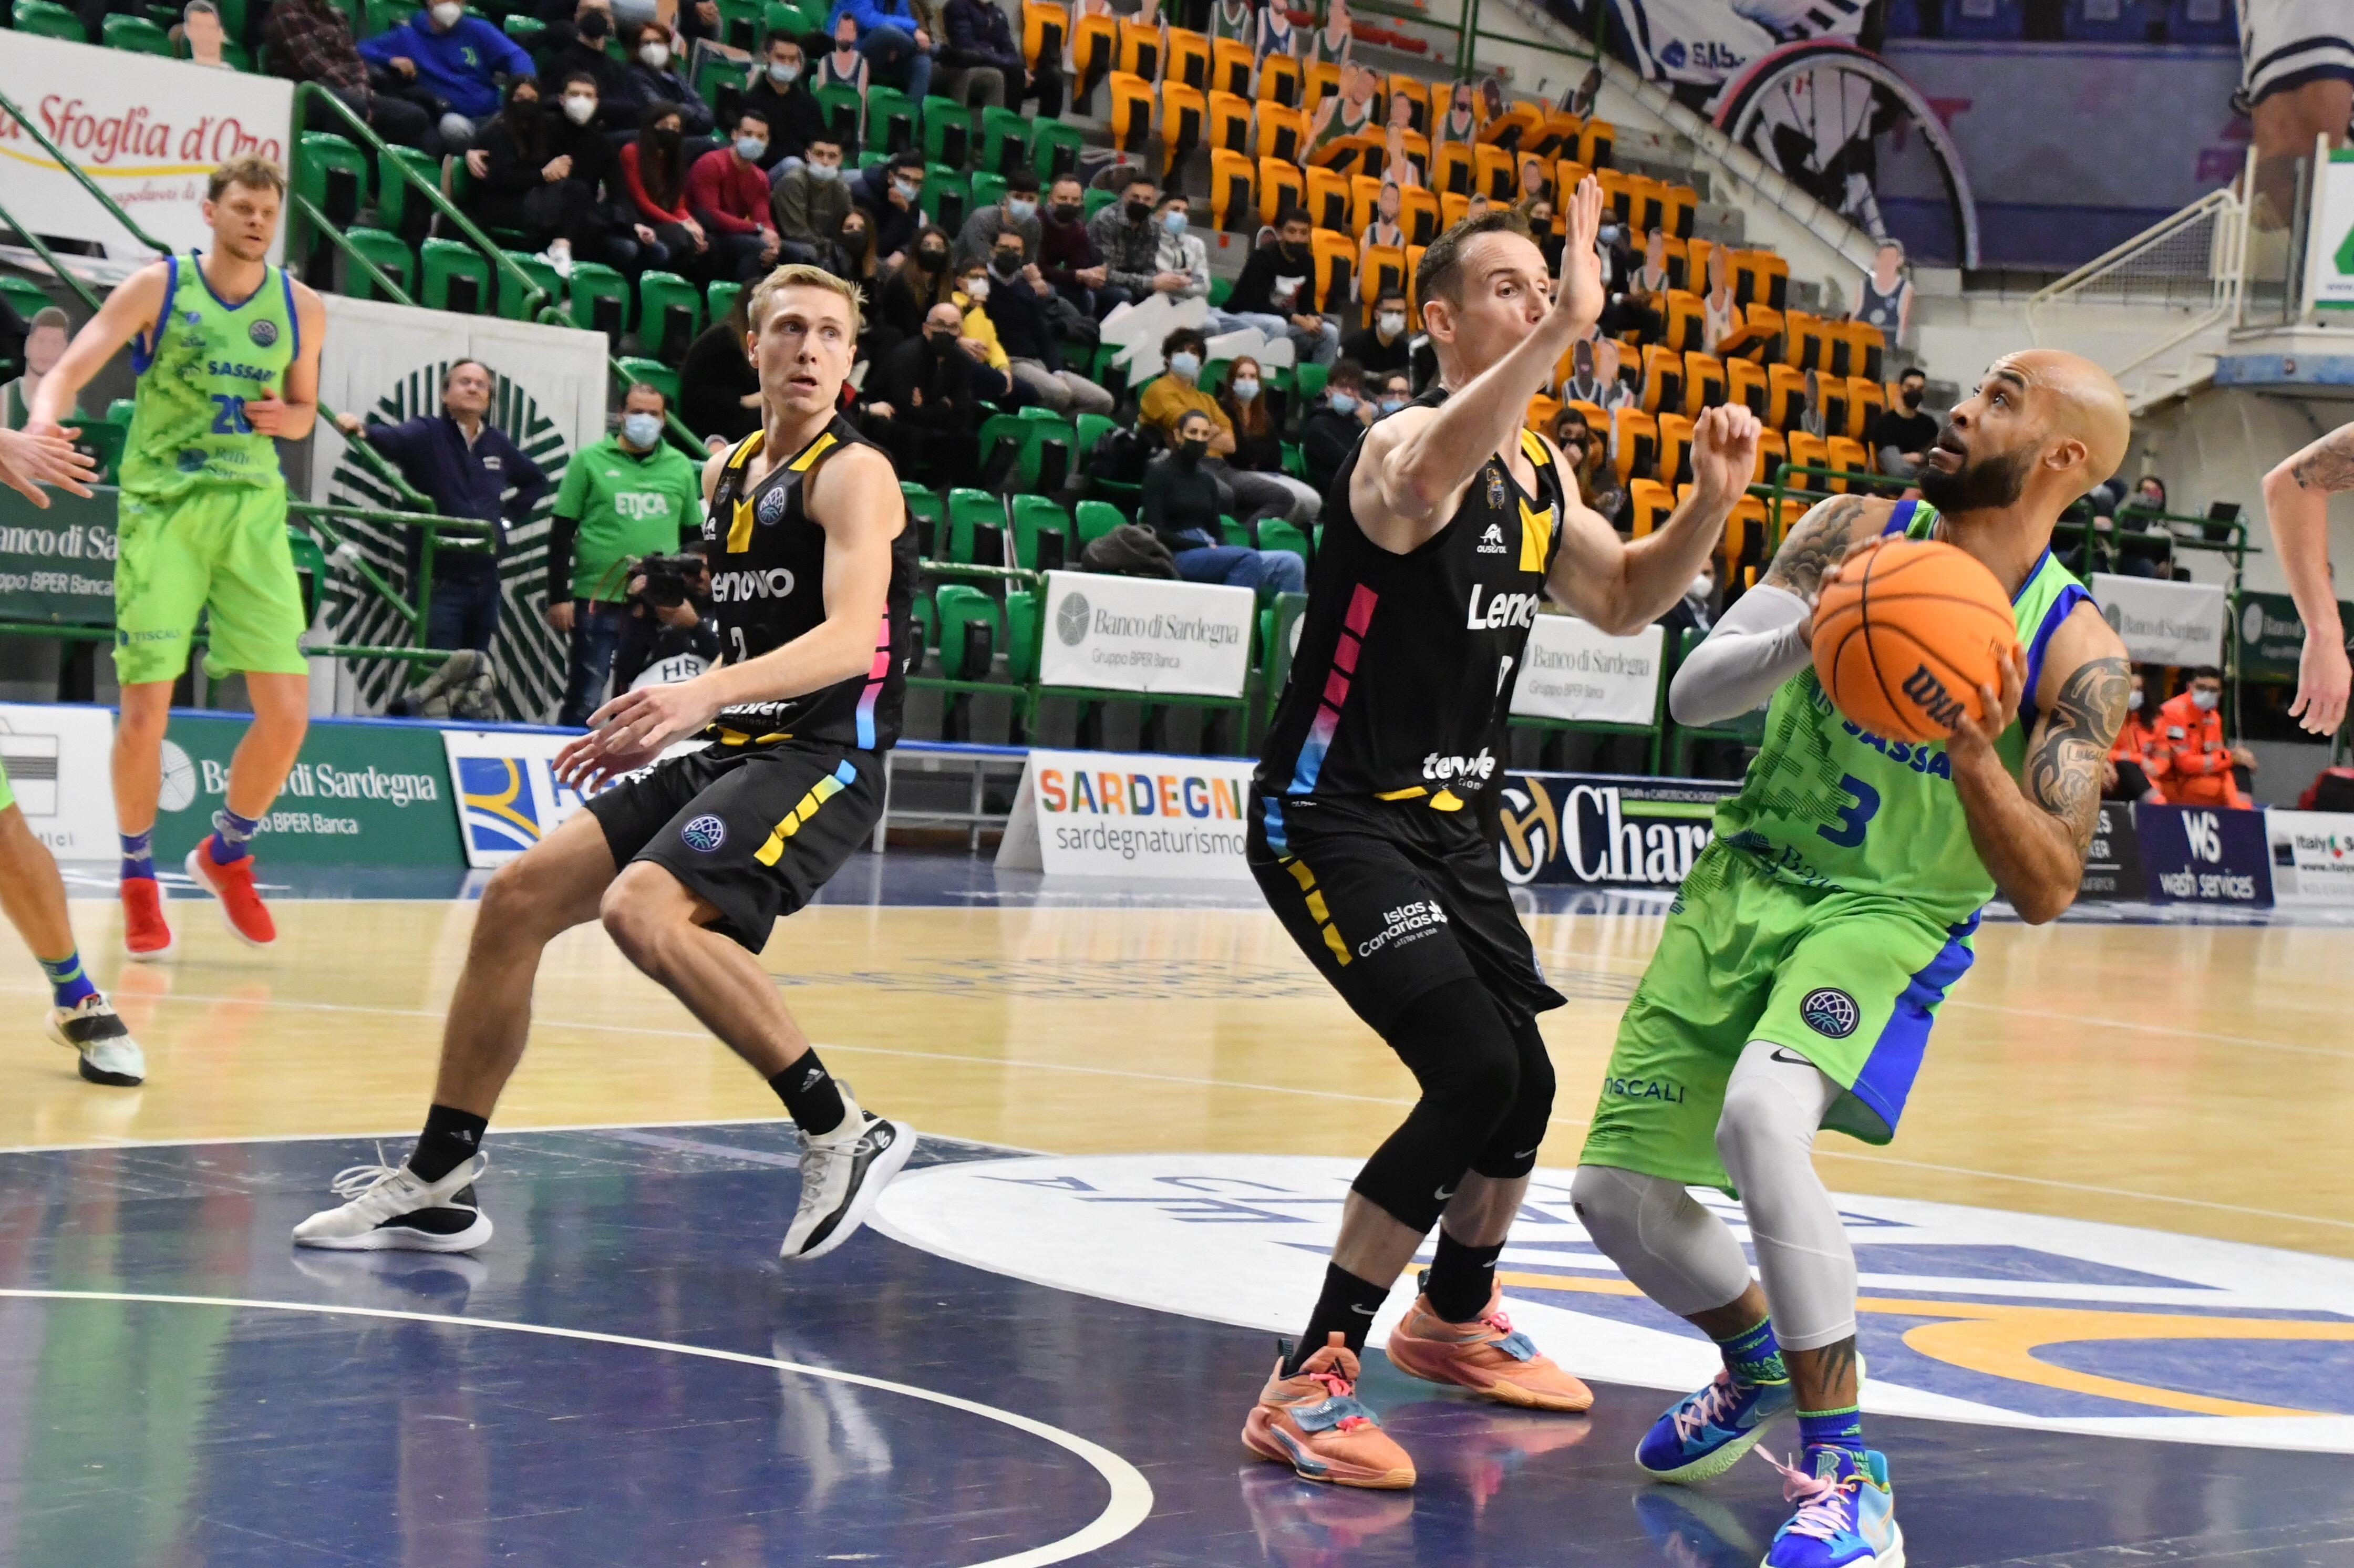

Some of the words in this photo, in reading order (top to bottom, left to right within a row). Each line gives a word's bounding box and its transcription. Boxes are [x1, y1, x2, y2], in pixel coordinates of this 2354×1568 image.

[39, 95, 171, 163] Sfoglia
[0, 526, 57, 557] anco
[58, 524, 83, 559] di
[30, 571, 69, 594] BPER
[710, 568, 794, 603] enovo
[1467, 584, 1540, 630] Leno
[1094, 608, 1145, 638] Banco
[1147, 612, 1163, 639] di
[1163, 613, 1238, 651] Sardegna
[1092, 647, 1128, 668] Gruppo
[1129, 649, 1153, 667] BPER
[1154, 651, 1181, 669] Banca
[1533, 644, 1575, 671] Banco
[1577, 649, 1589, 672] di
[1592, 649, 1650, 680] Sardegna
[290, 762, 315, 797] di
[316, 762, 438, 808] Sardegna
[1039, 769, 1243, 821] SARDEGN
[272, 811, 312, 833] BPER
[314, 812, 359, 834] Banca
[1816, 772, 1881, 849] 3
[1562, 784, 1714, 883] Char
[2181, 810, 2223, 864] WS
[2160, 863, 2197, 897] wash
[2199, 868, 2256, 900] services
[1382, 901, 1427, 925] Islas
[1358, 913, 1432, 957] Canarias
